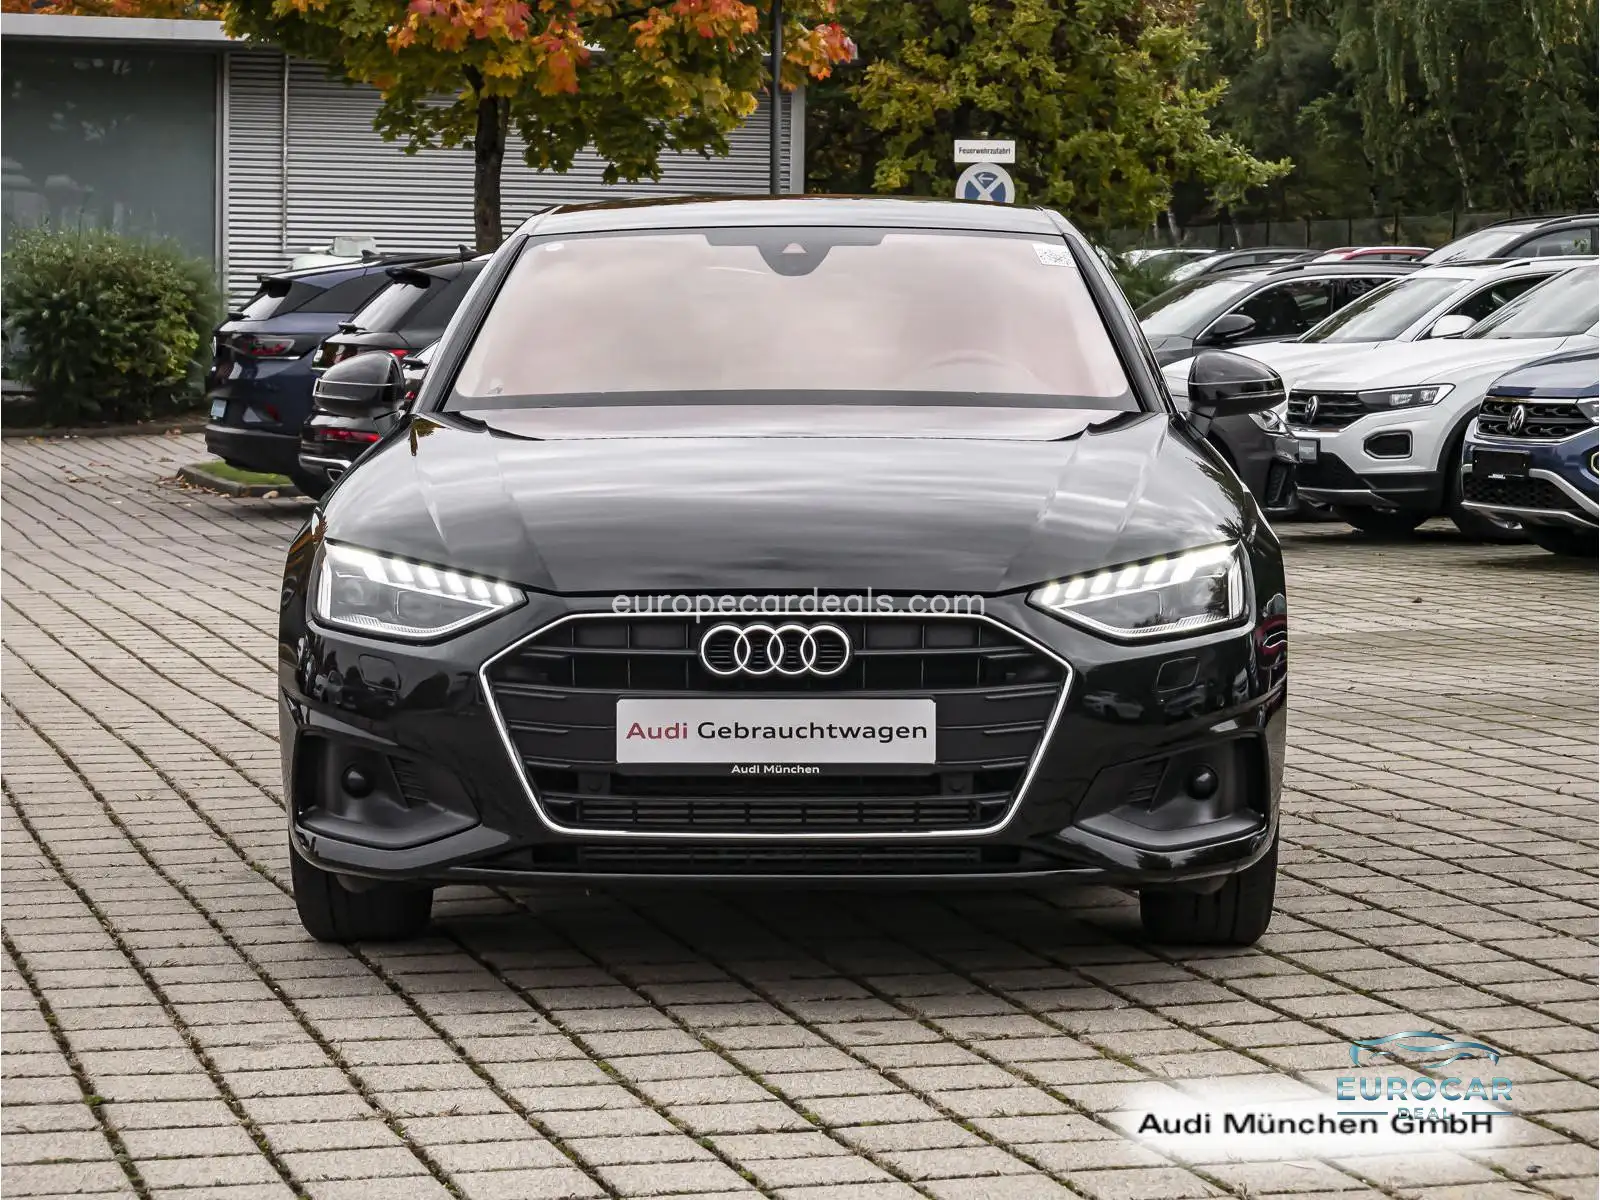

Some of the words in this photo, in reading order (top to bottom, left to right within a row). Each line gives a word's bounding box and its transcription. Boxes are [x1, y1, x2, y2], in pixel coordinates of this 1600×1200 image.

[626, 722, 688, 739] Audi
[697, 721, 928, 744] Gebrauchtwagen
[731, 764, 760, 774] Audi
[763, 763, 820, 774] München
